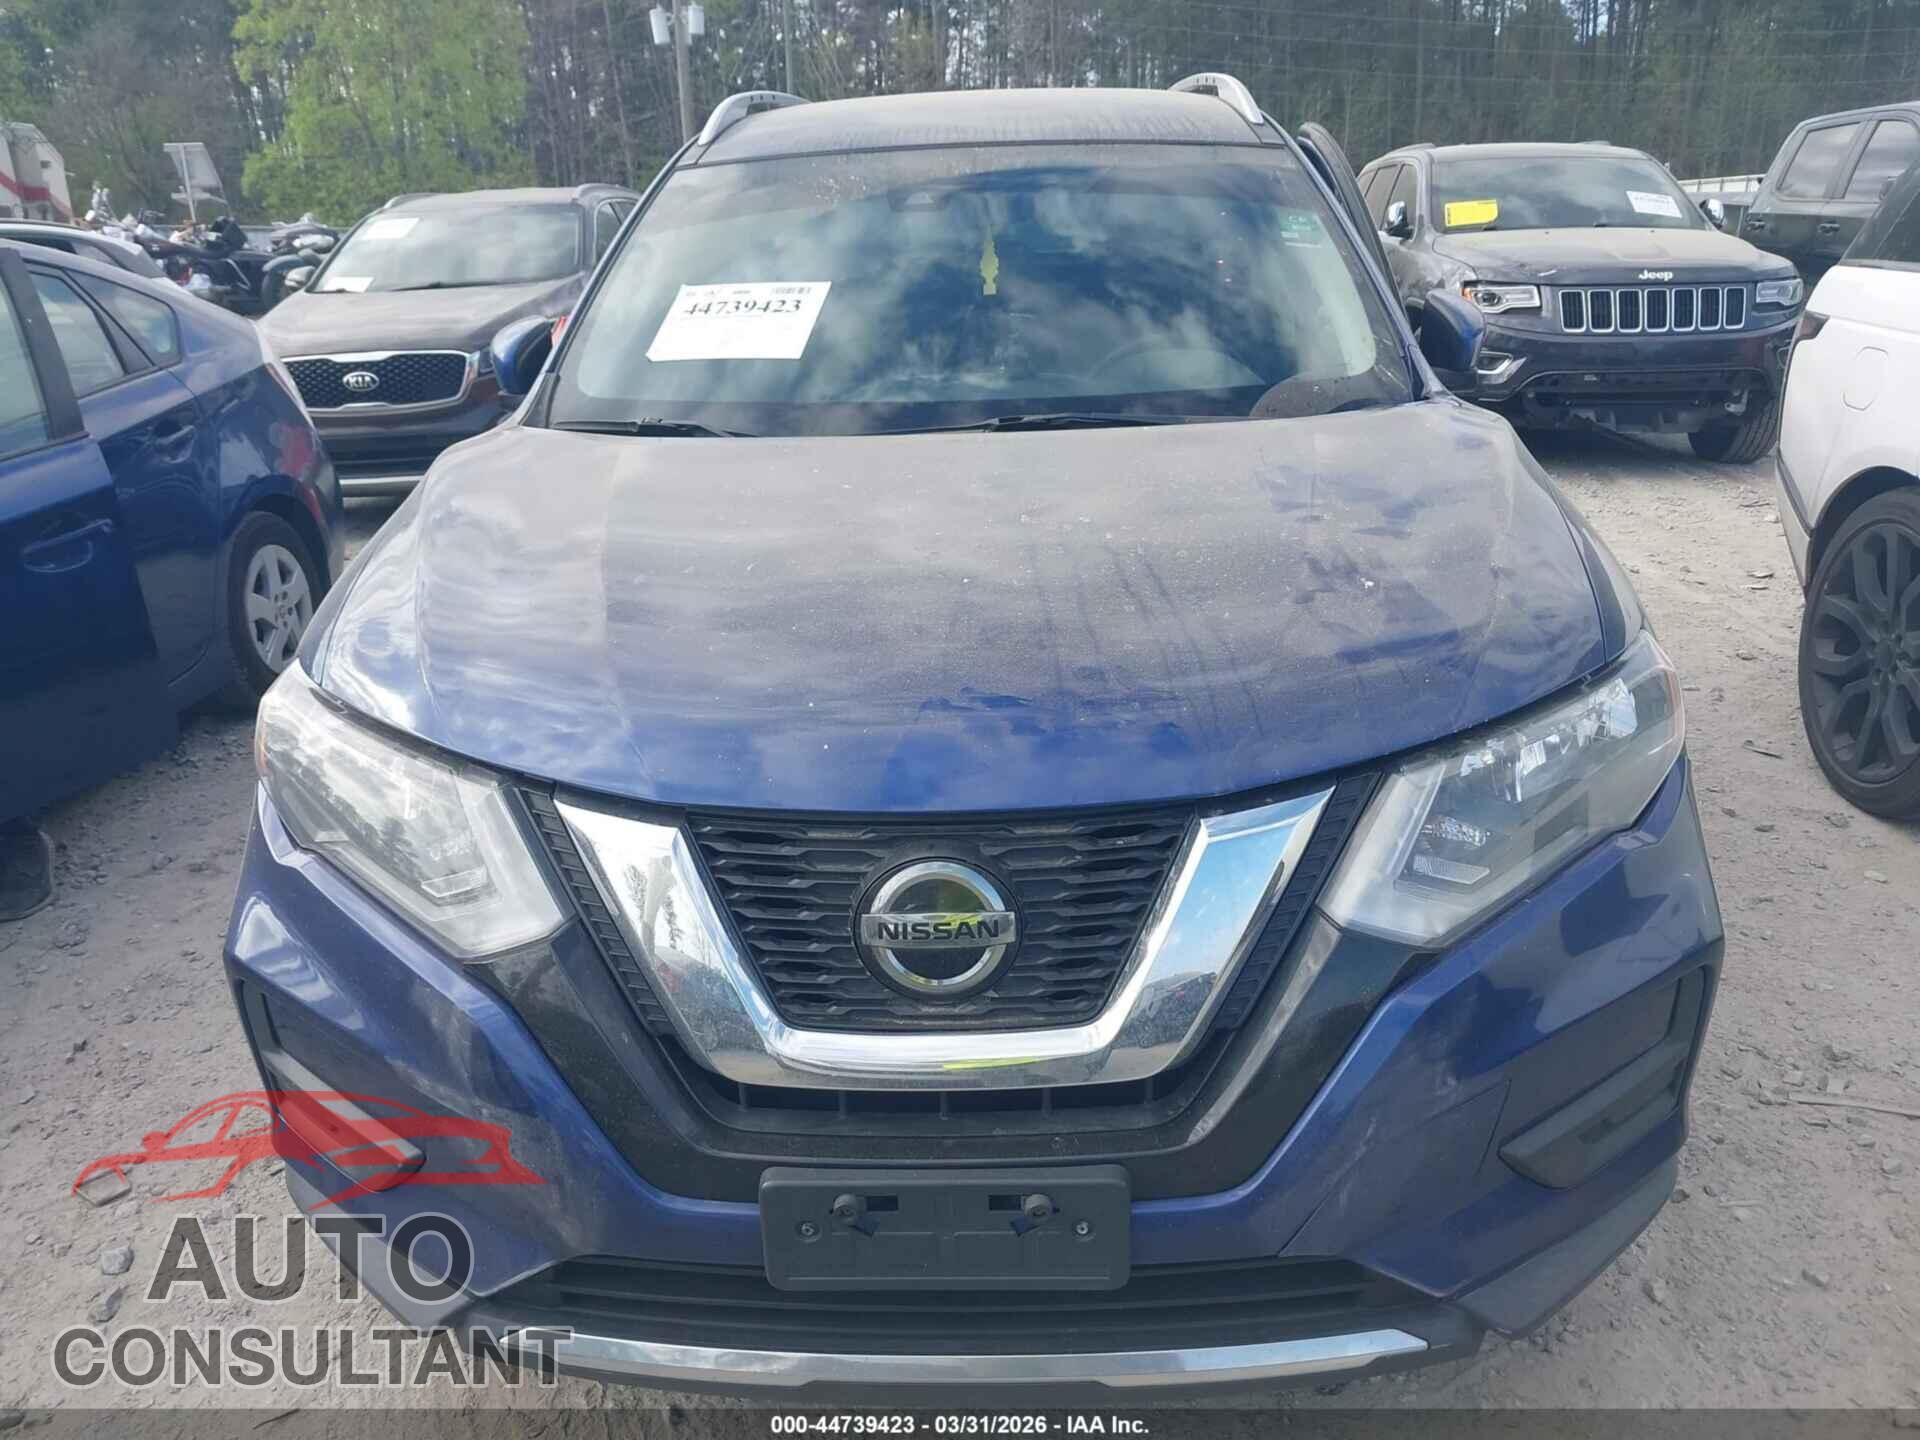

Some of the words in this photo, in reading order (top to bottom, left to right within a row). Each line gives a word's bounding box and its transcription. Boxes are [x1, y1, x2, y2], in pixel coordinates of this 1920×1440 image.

[1638, 269, 1673, 281] Jeep
[683, 299, 802, 315] 44739423
[345, 373, 376, 389] KIA
[877, 919, 999, 940] NISSAN
